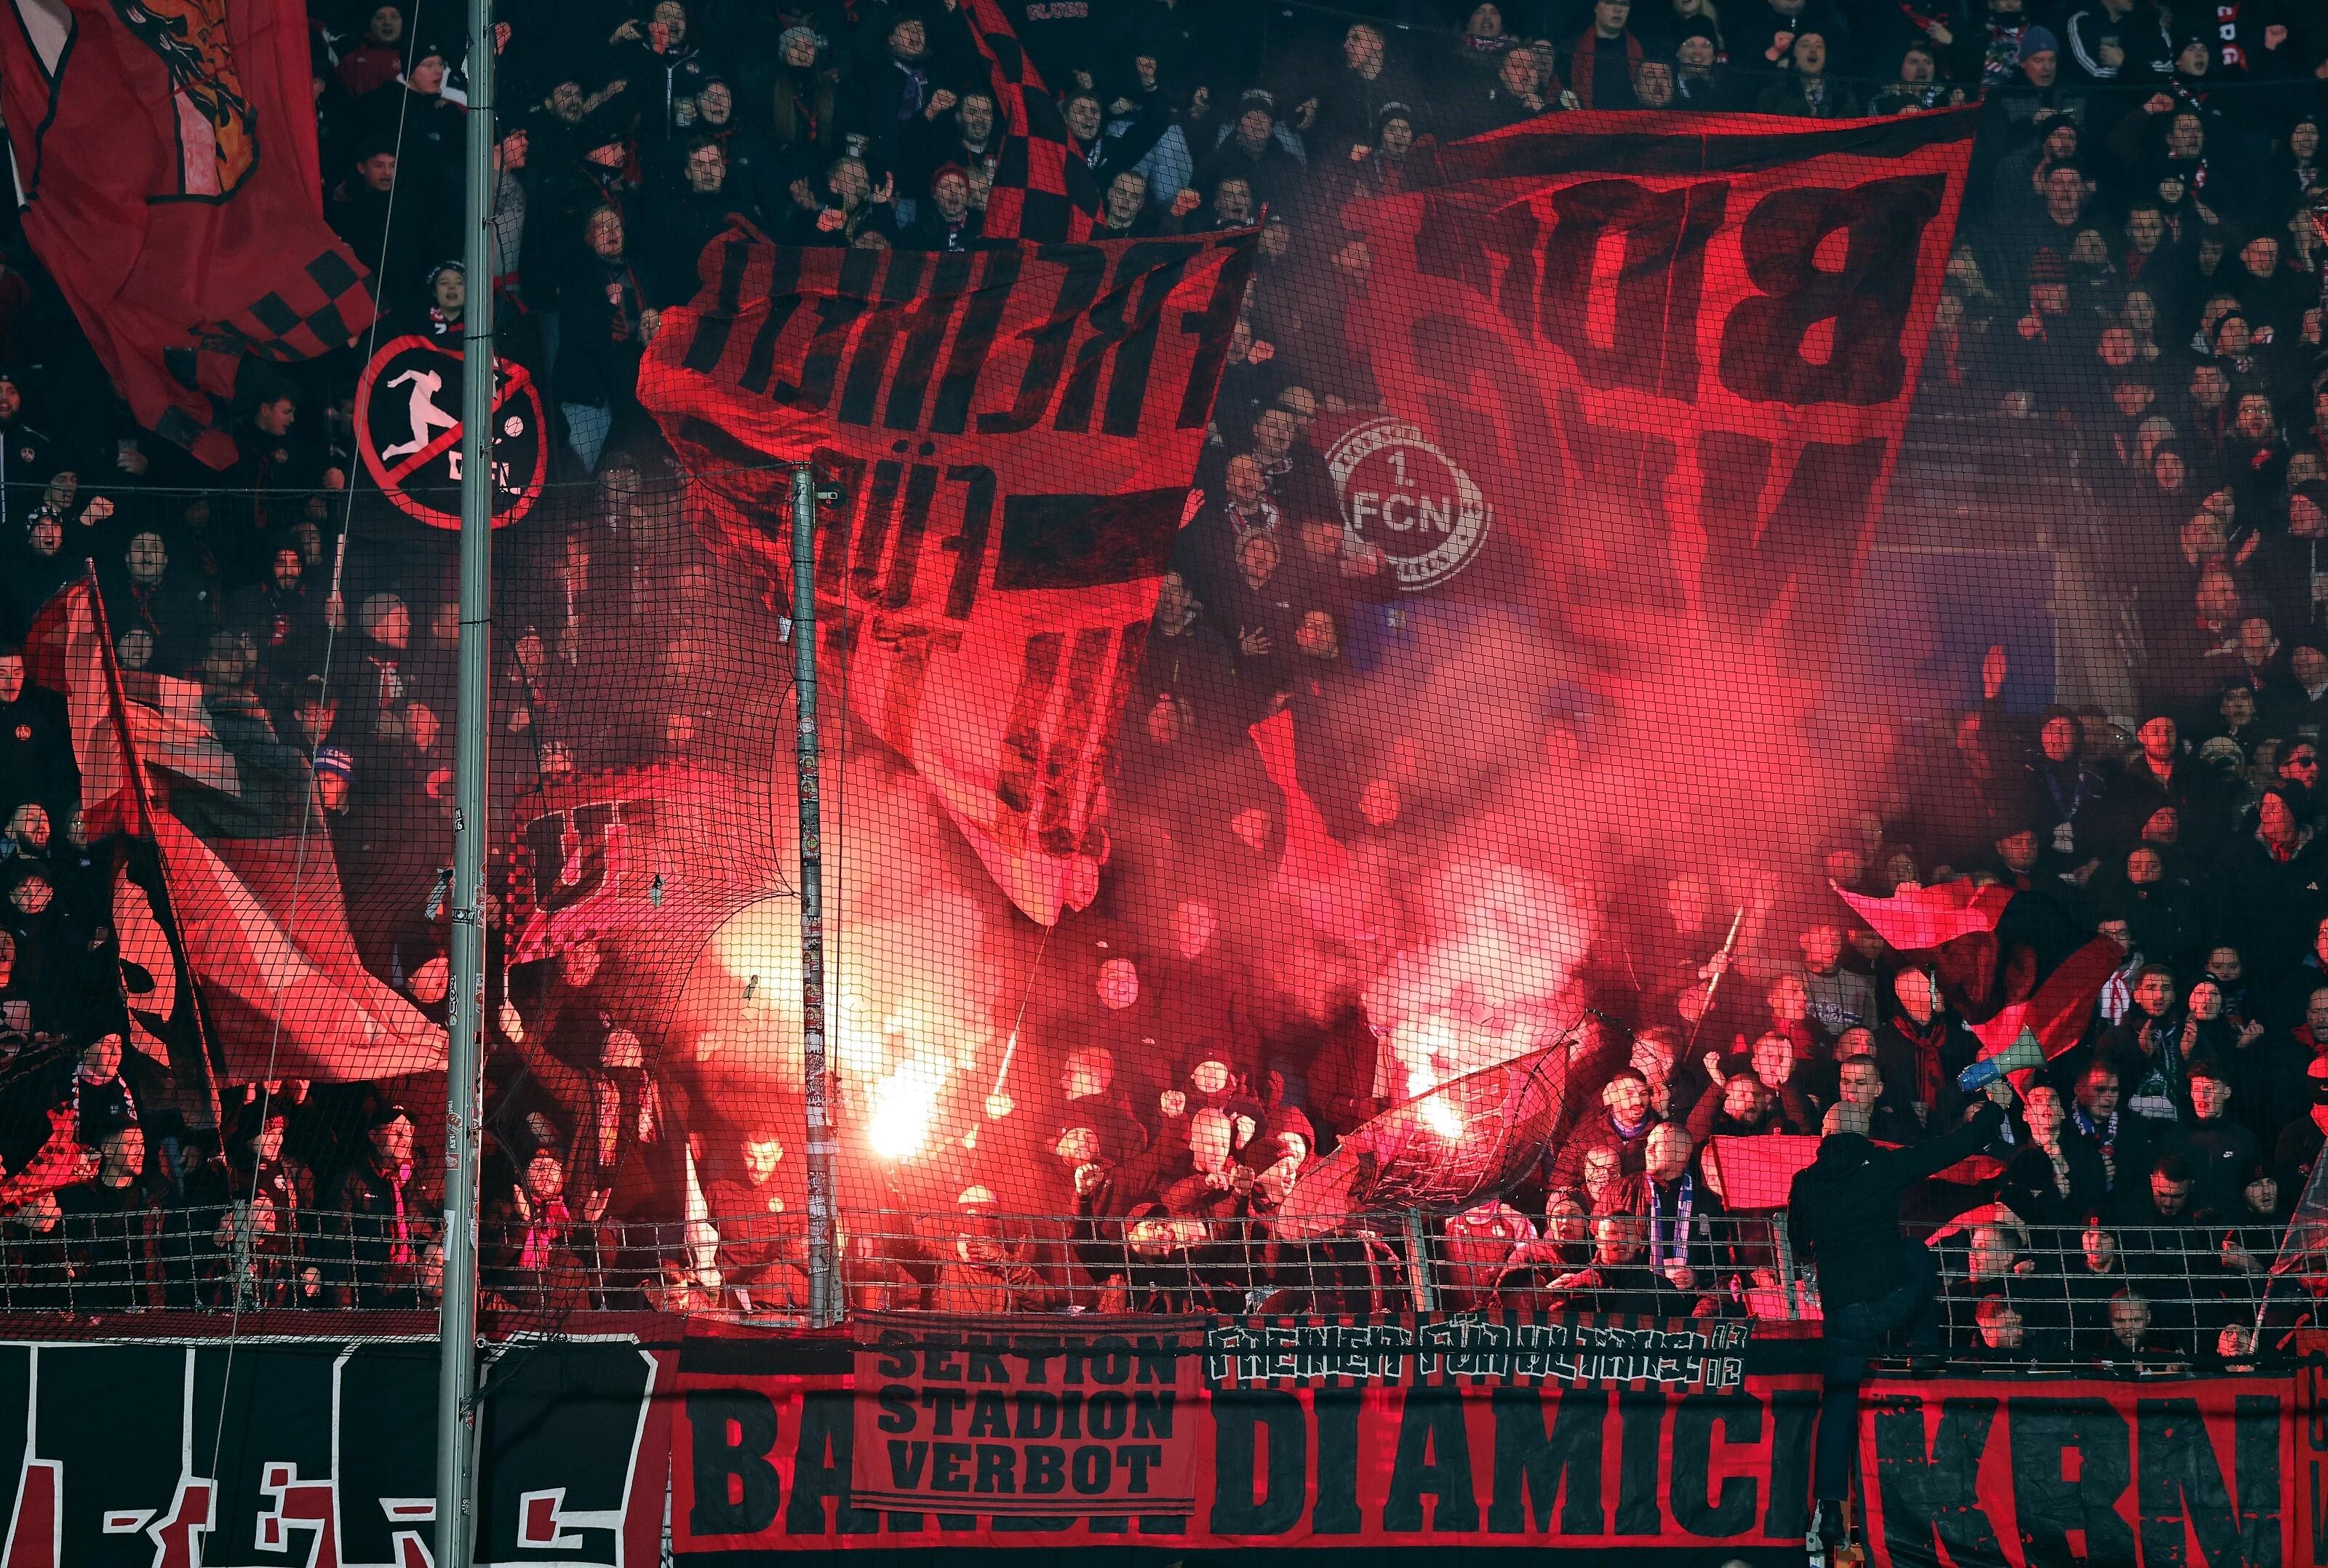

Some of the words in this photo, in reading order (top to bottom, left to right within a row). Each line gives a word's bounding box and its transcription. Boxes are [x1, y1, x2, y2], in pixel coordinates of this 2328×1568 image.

[1352, 492, 1451, 533] FCN
[878, 1329, 1179, 1385] SEKTION
[877, 1384, 1176, 1439] STADION
[887, 1439, 1162, 1495] VERBOT
[1211, 1385, 1363, 1536] DI
[1384, 1385, 1821, 1540] AMICI
